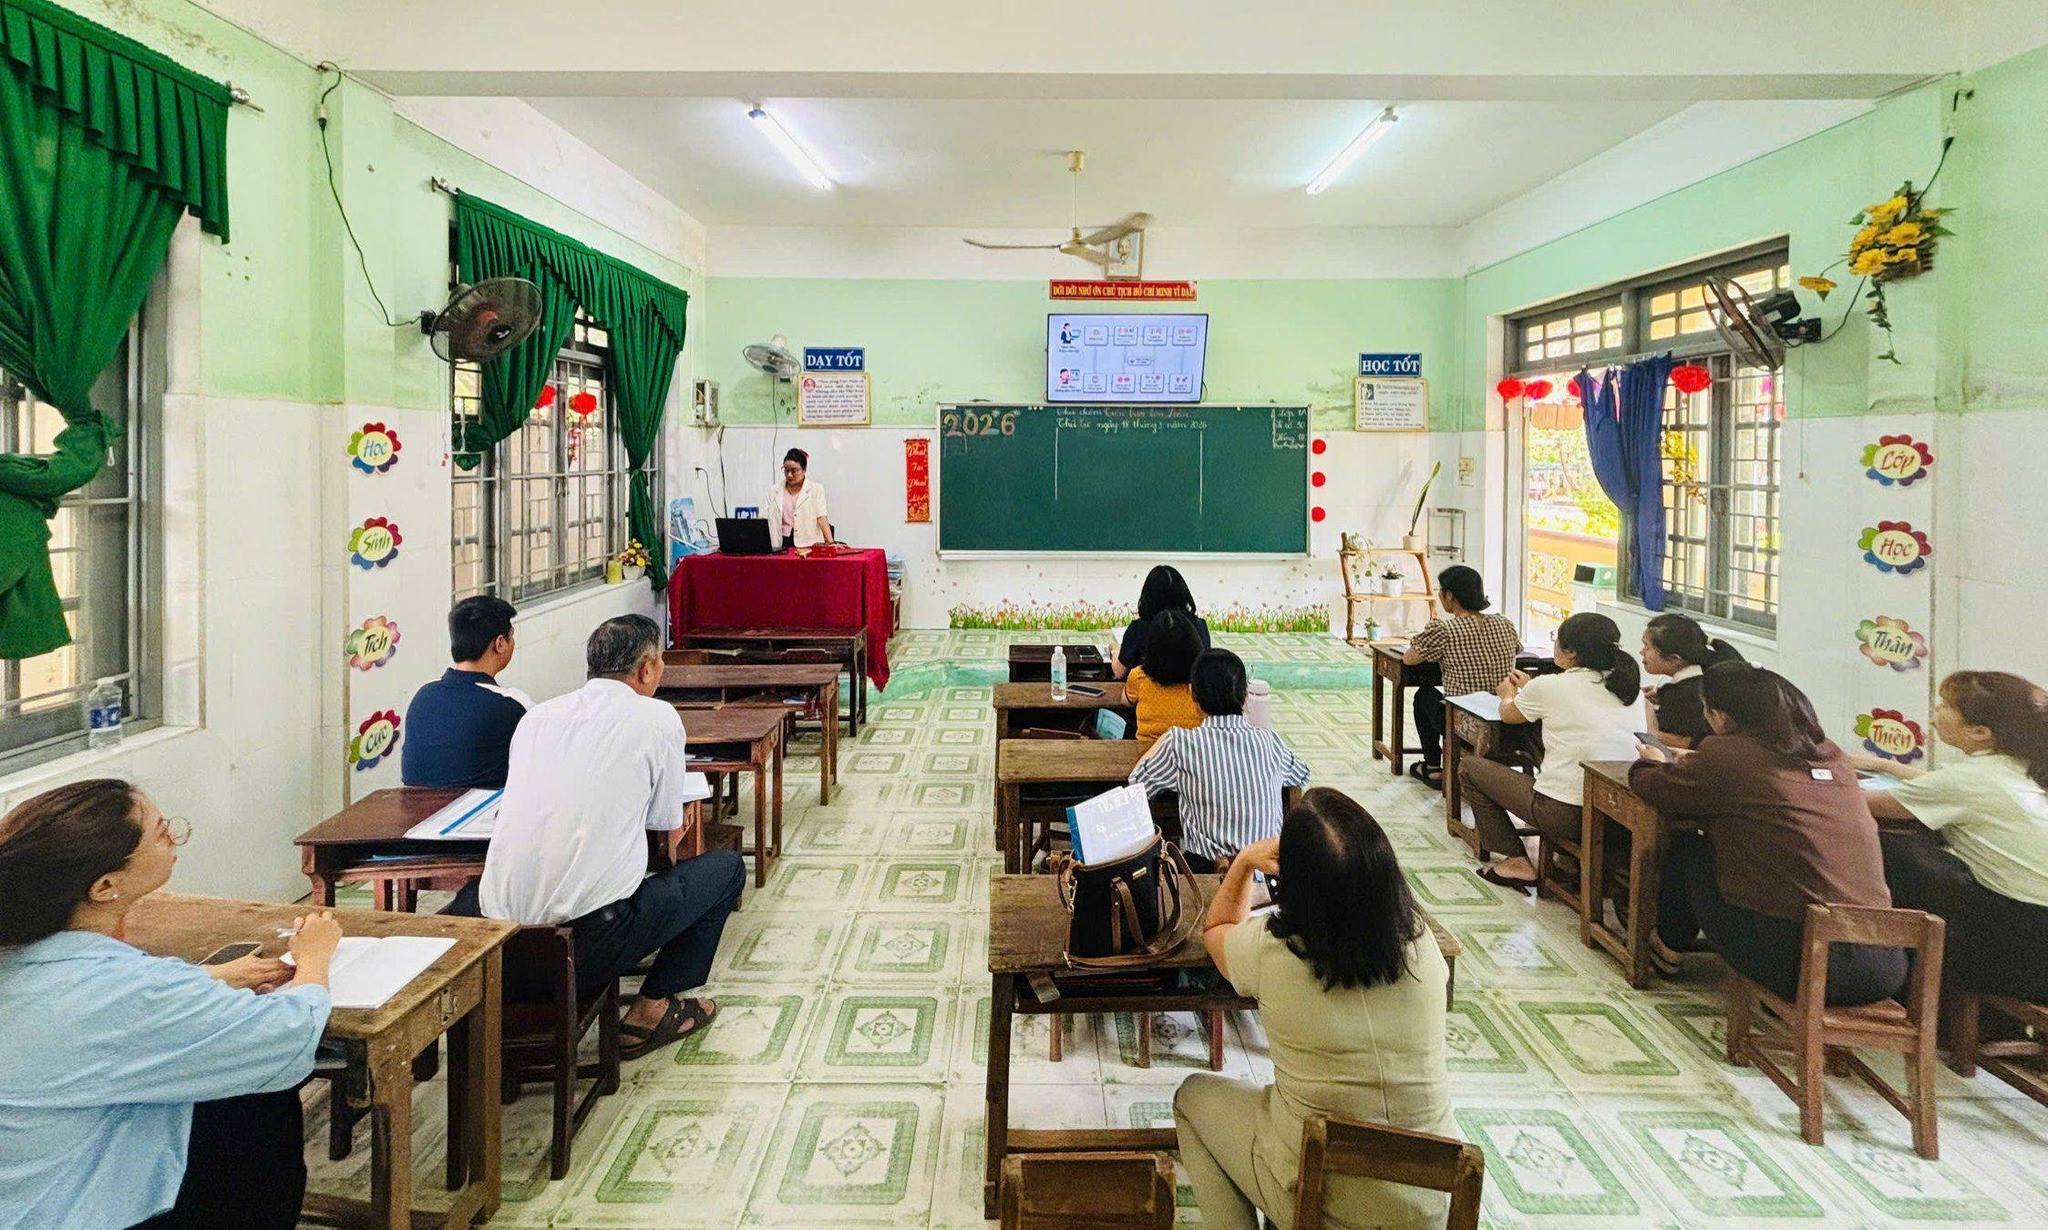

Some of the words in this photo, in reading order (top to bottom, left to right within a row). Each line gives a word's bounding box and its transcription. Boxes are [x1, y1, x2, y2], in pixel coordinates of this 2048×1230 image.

[1102, 282, 1116, 296] CHỦ
[1117, 287, 1132, 299] TỊCH
[1133, 283, 1142, 296] HỒ
[1143, 285, 1155, 296] CHÍ
[1156, 287, 1172, 297] MINH
[807, 355, 834, 368] DẠY
[836, 351, 862, 367] TỐT
[1362, 359, 1390, 374] HỌC
[1393, 355, 1420, 372] TỐT
[943, 412, 1016, 437] 2026
[1096, 420, 1119, 434] ngày
[363, 439, 388, 461] Học
[1880, 450, 1915, 474] Lớp
[363, 532, 391, 553] Sinh
[1880, 538, 1913, 560] Học
[1873, 630, 1914, 657] Thân
[1872, 724, 1912, 752] Thiện
